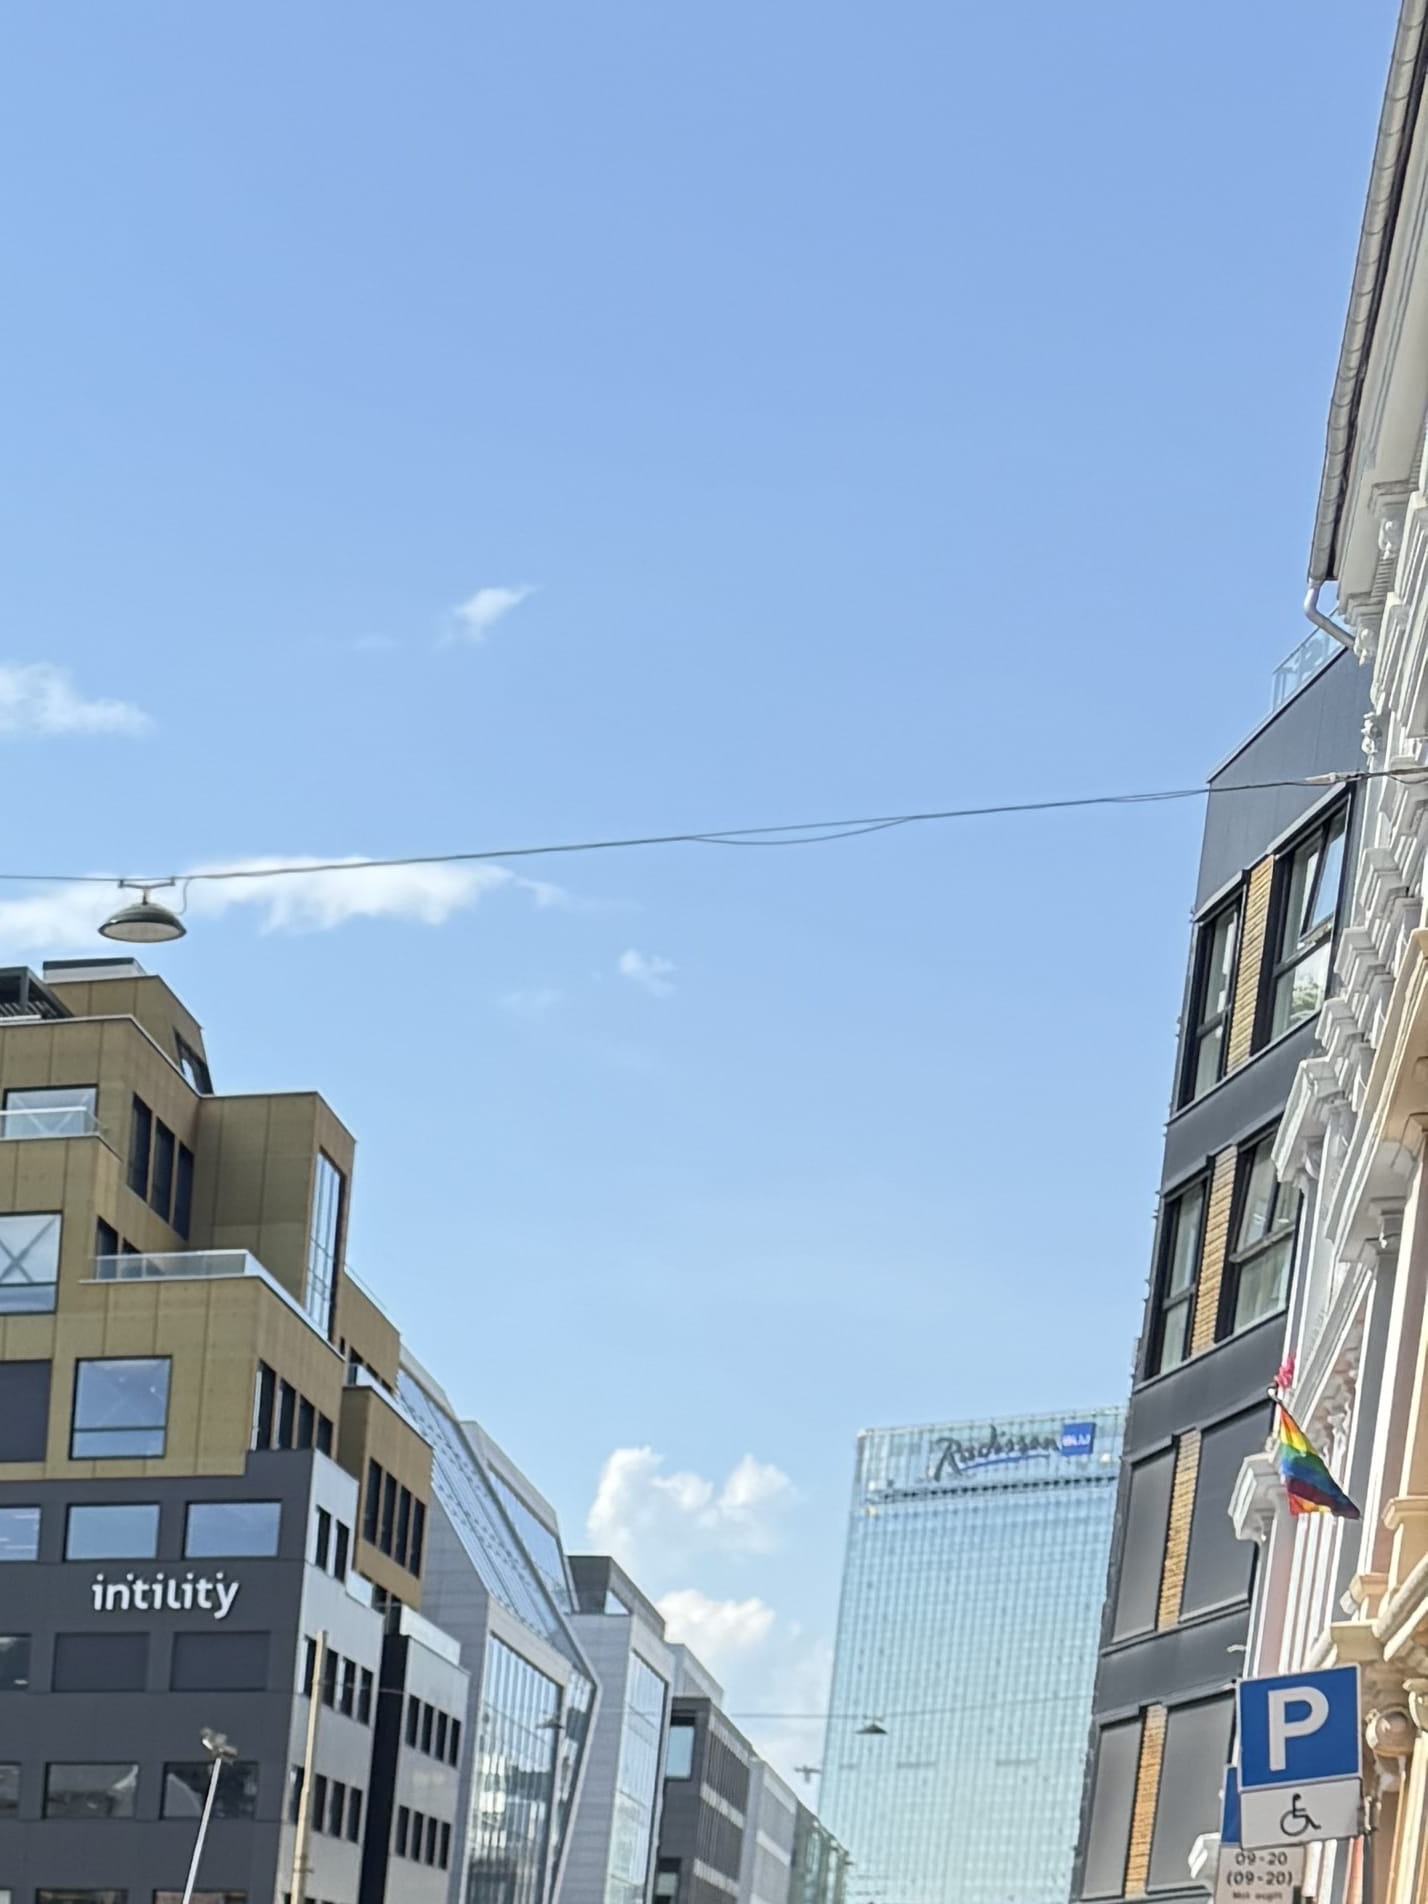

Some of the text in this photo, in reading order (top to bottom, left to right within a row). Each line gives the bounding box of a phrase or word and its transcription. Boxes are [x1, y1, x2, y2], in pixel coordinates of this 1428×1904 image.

[933, 1424, 1061, 1482] Radisson
[92, 1572, 240, 1620] intility
[1267, 1686, 1330, 1772] P
